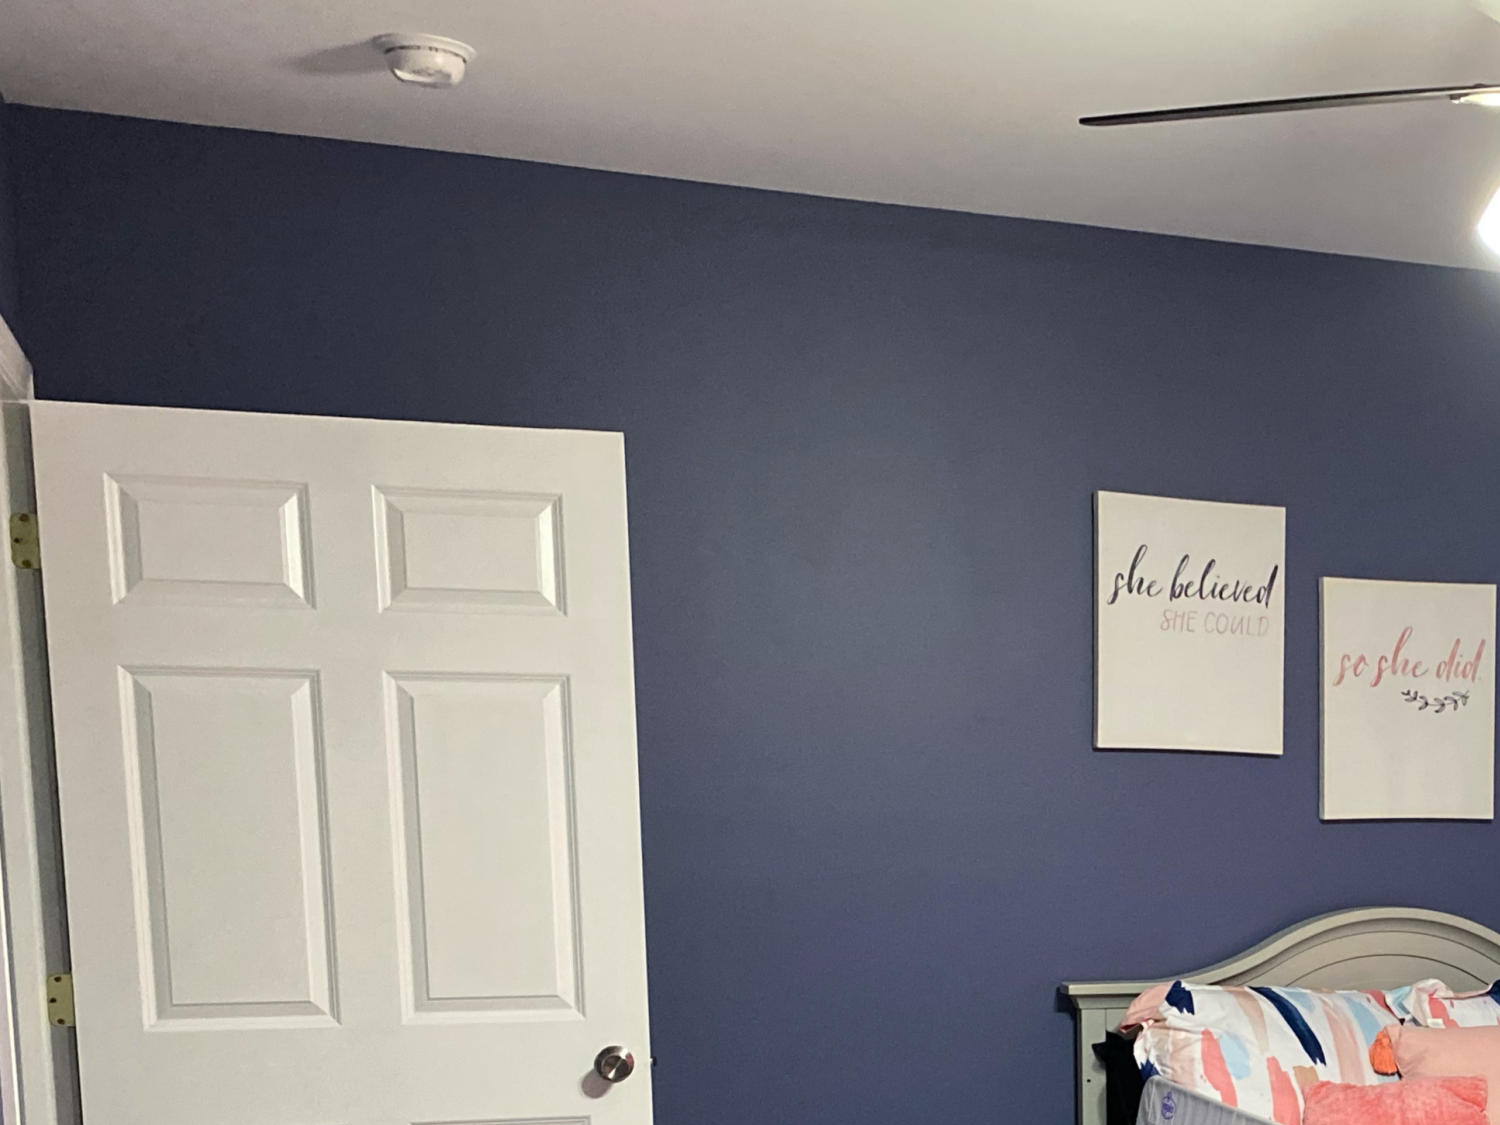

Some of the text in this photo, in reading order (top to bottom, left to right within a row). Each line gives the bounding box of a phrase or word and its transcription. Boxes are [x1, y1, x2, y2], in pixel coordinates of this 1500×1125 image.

[1107, 544, 1279, 609] she believed
[1160, 608, 1270, 637] SHE COULD
[1333, 654, 1368, 686] so
[1370, 625, 1429, 688] she
